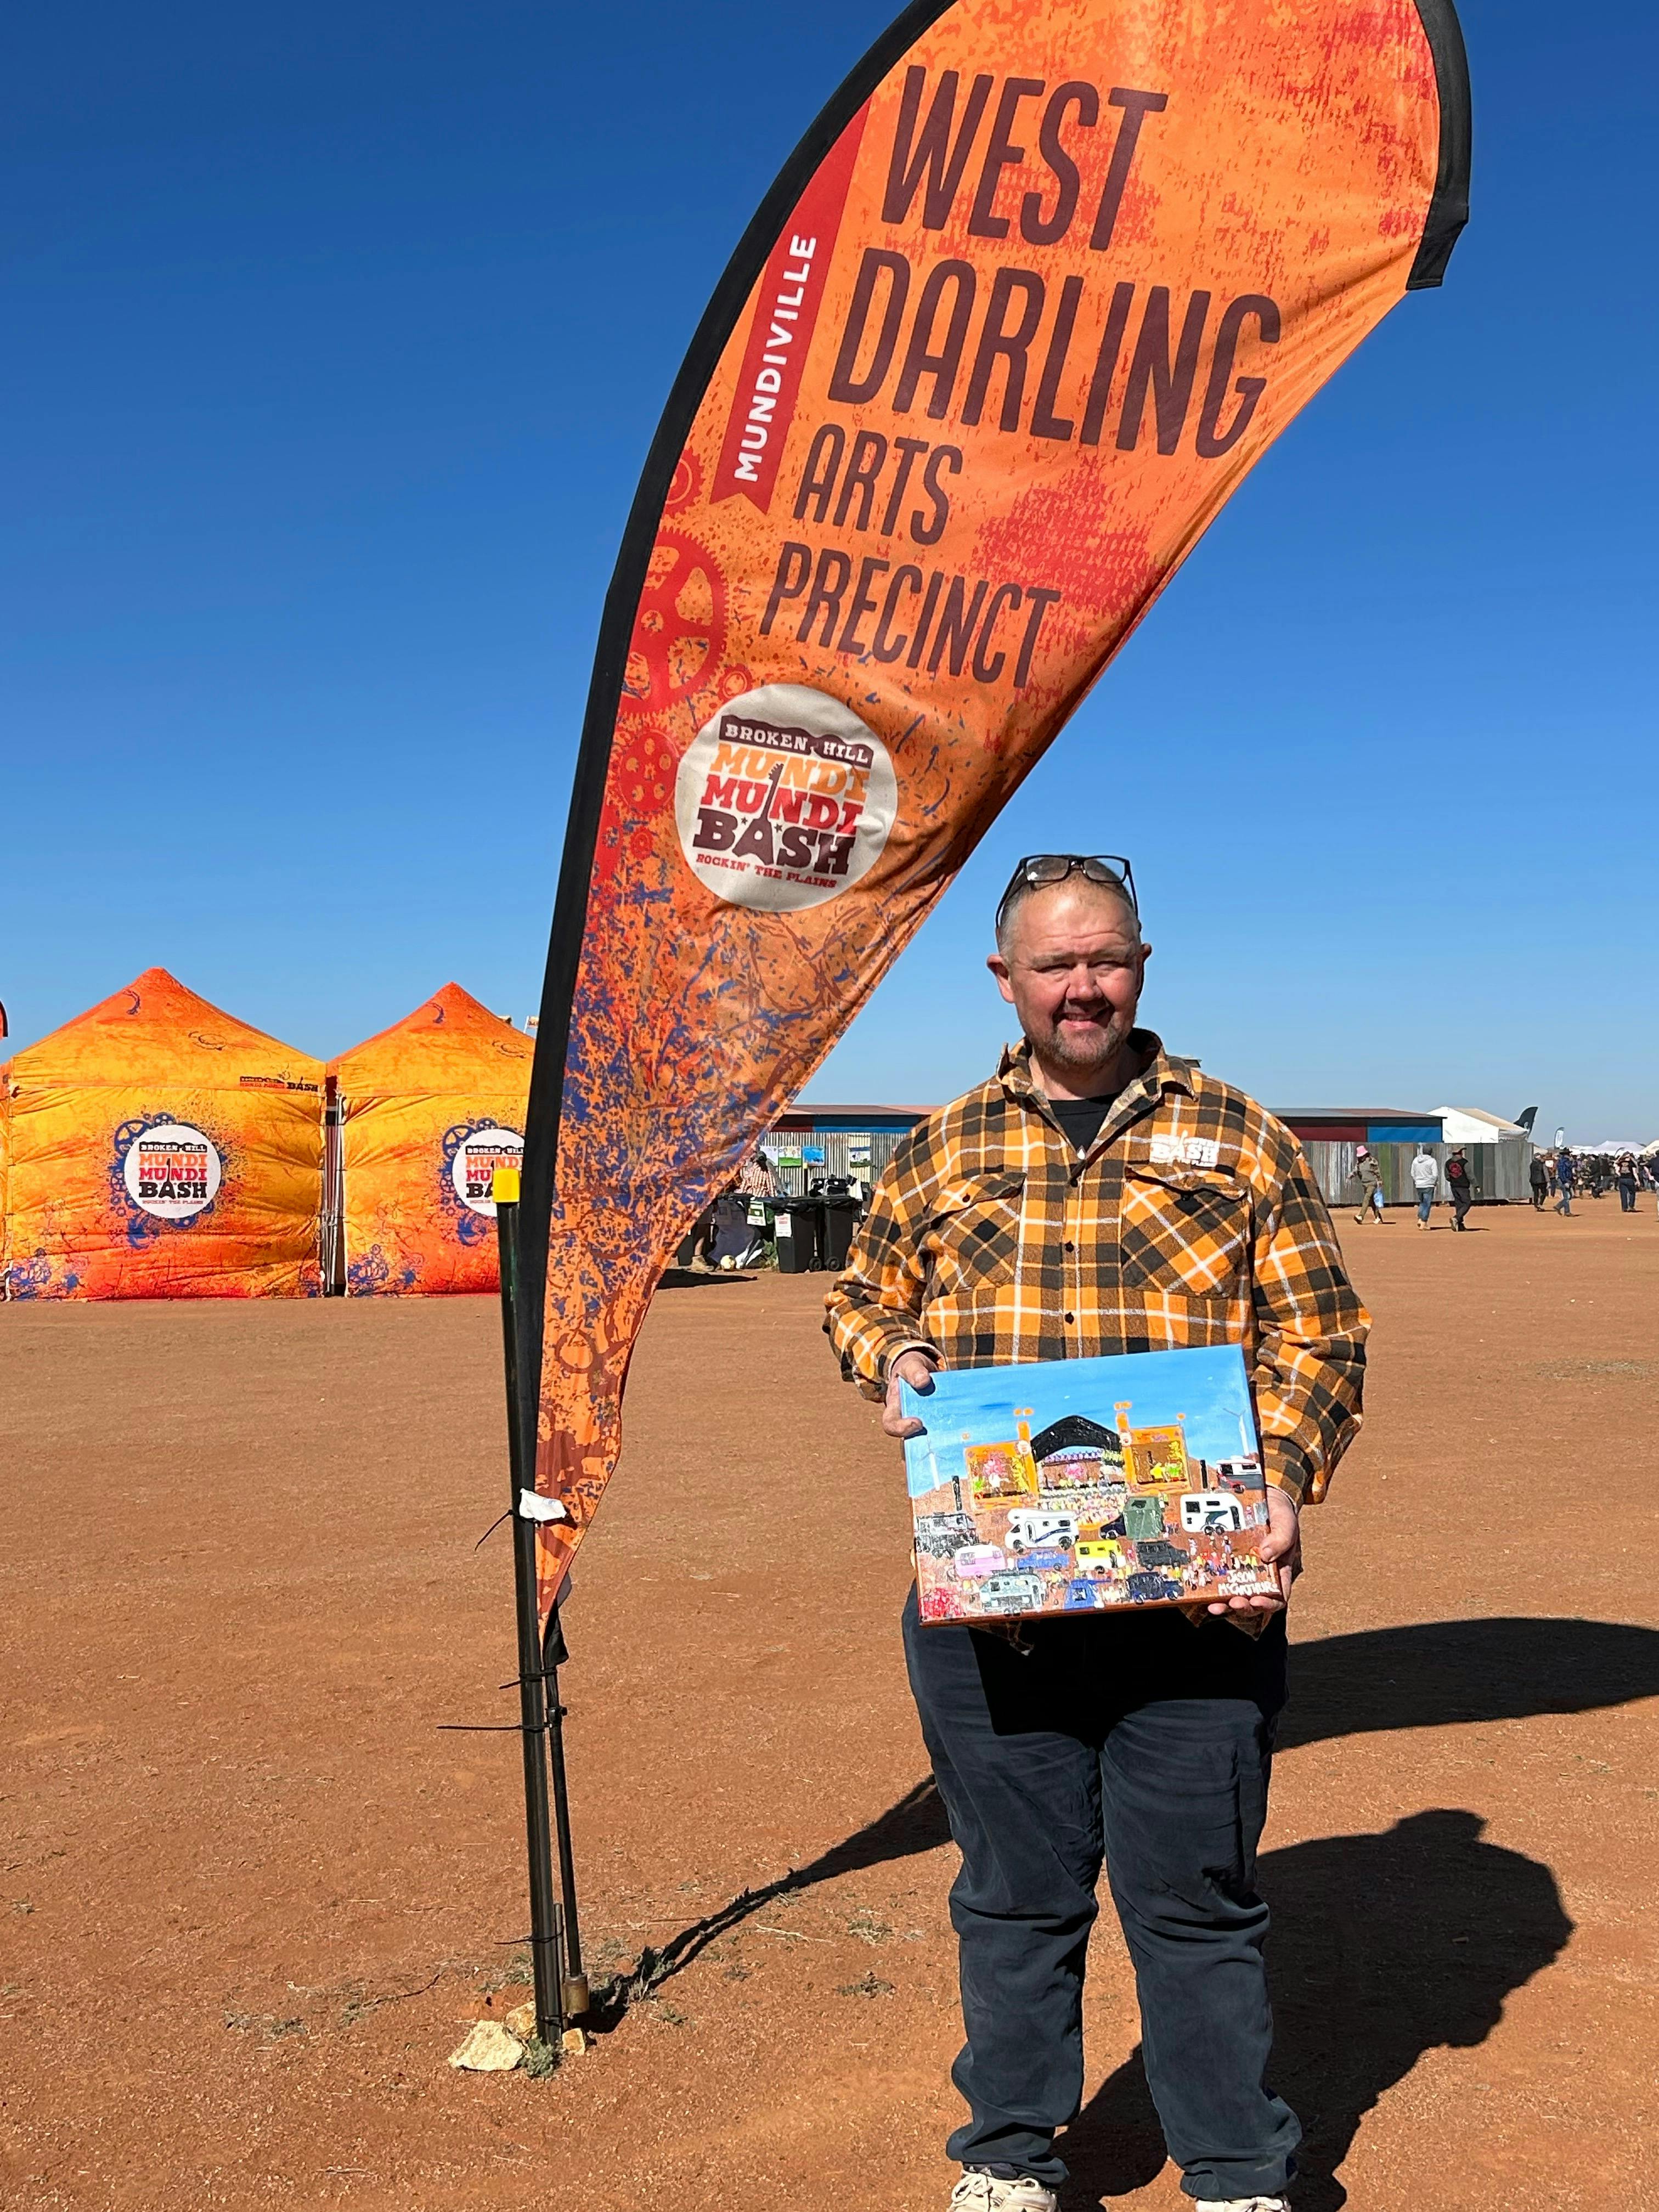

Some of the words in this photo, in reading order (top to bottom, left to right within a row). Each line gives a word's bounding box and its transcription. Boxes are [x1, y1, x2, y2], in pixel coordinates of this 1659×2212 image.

[881, 66, 1168, 251] WEST
[734, 234, 817, 482] MUNDIVILLE
[827, 248, 1280, 459] DARLING
[793, 424, 962, 545] ARTS
[759, 541, 1062, 689] PRECINCT
[709, 743, 870, 802] MUNDI
[725, 723, 808, 751] BROKEN
[823, 741, 868, 764] HILL
[701, 774, 864, 836] MUNDI
[693, 808, 855, 875] BASH
[696, 854, 751, 872] ROCKIN'
[754, 865, 782, 878] THE
[786, 872, 838, 889] PLAINS
[139, 1154, 207, 1166] MUNDI
[139, 1167, 207, 1181] MUNDI
[139, 1181, 207, 1199] BASH
